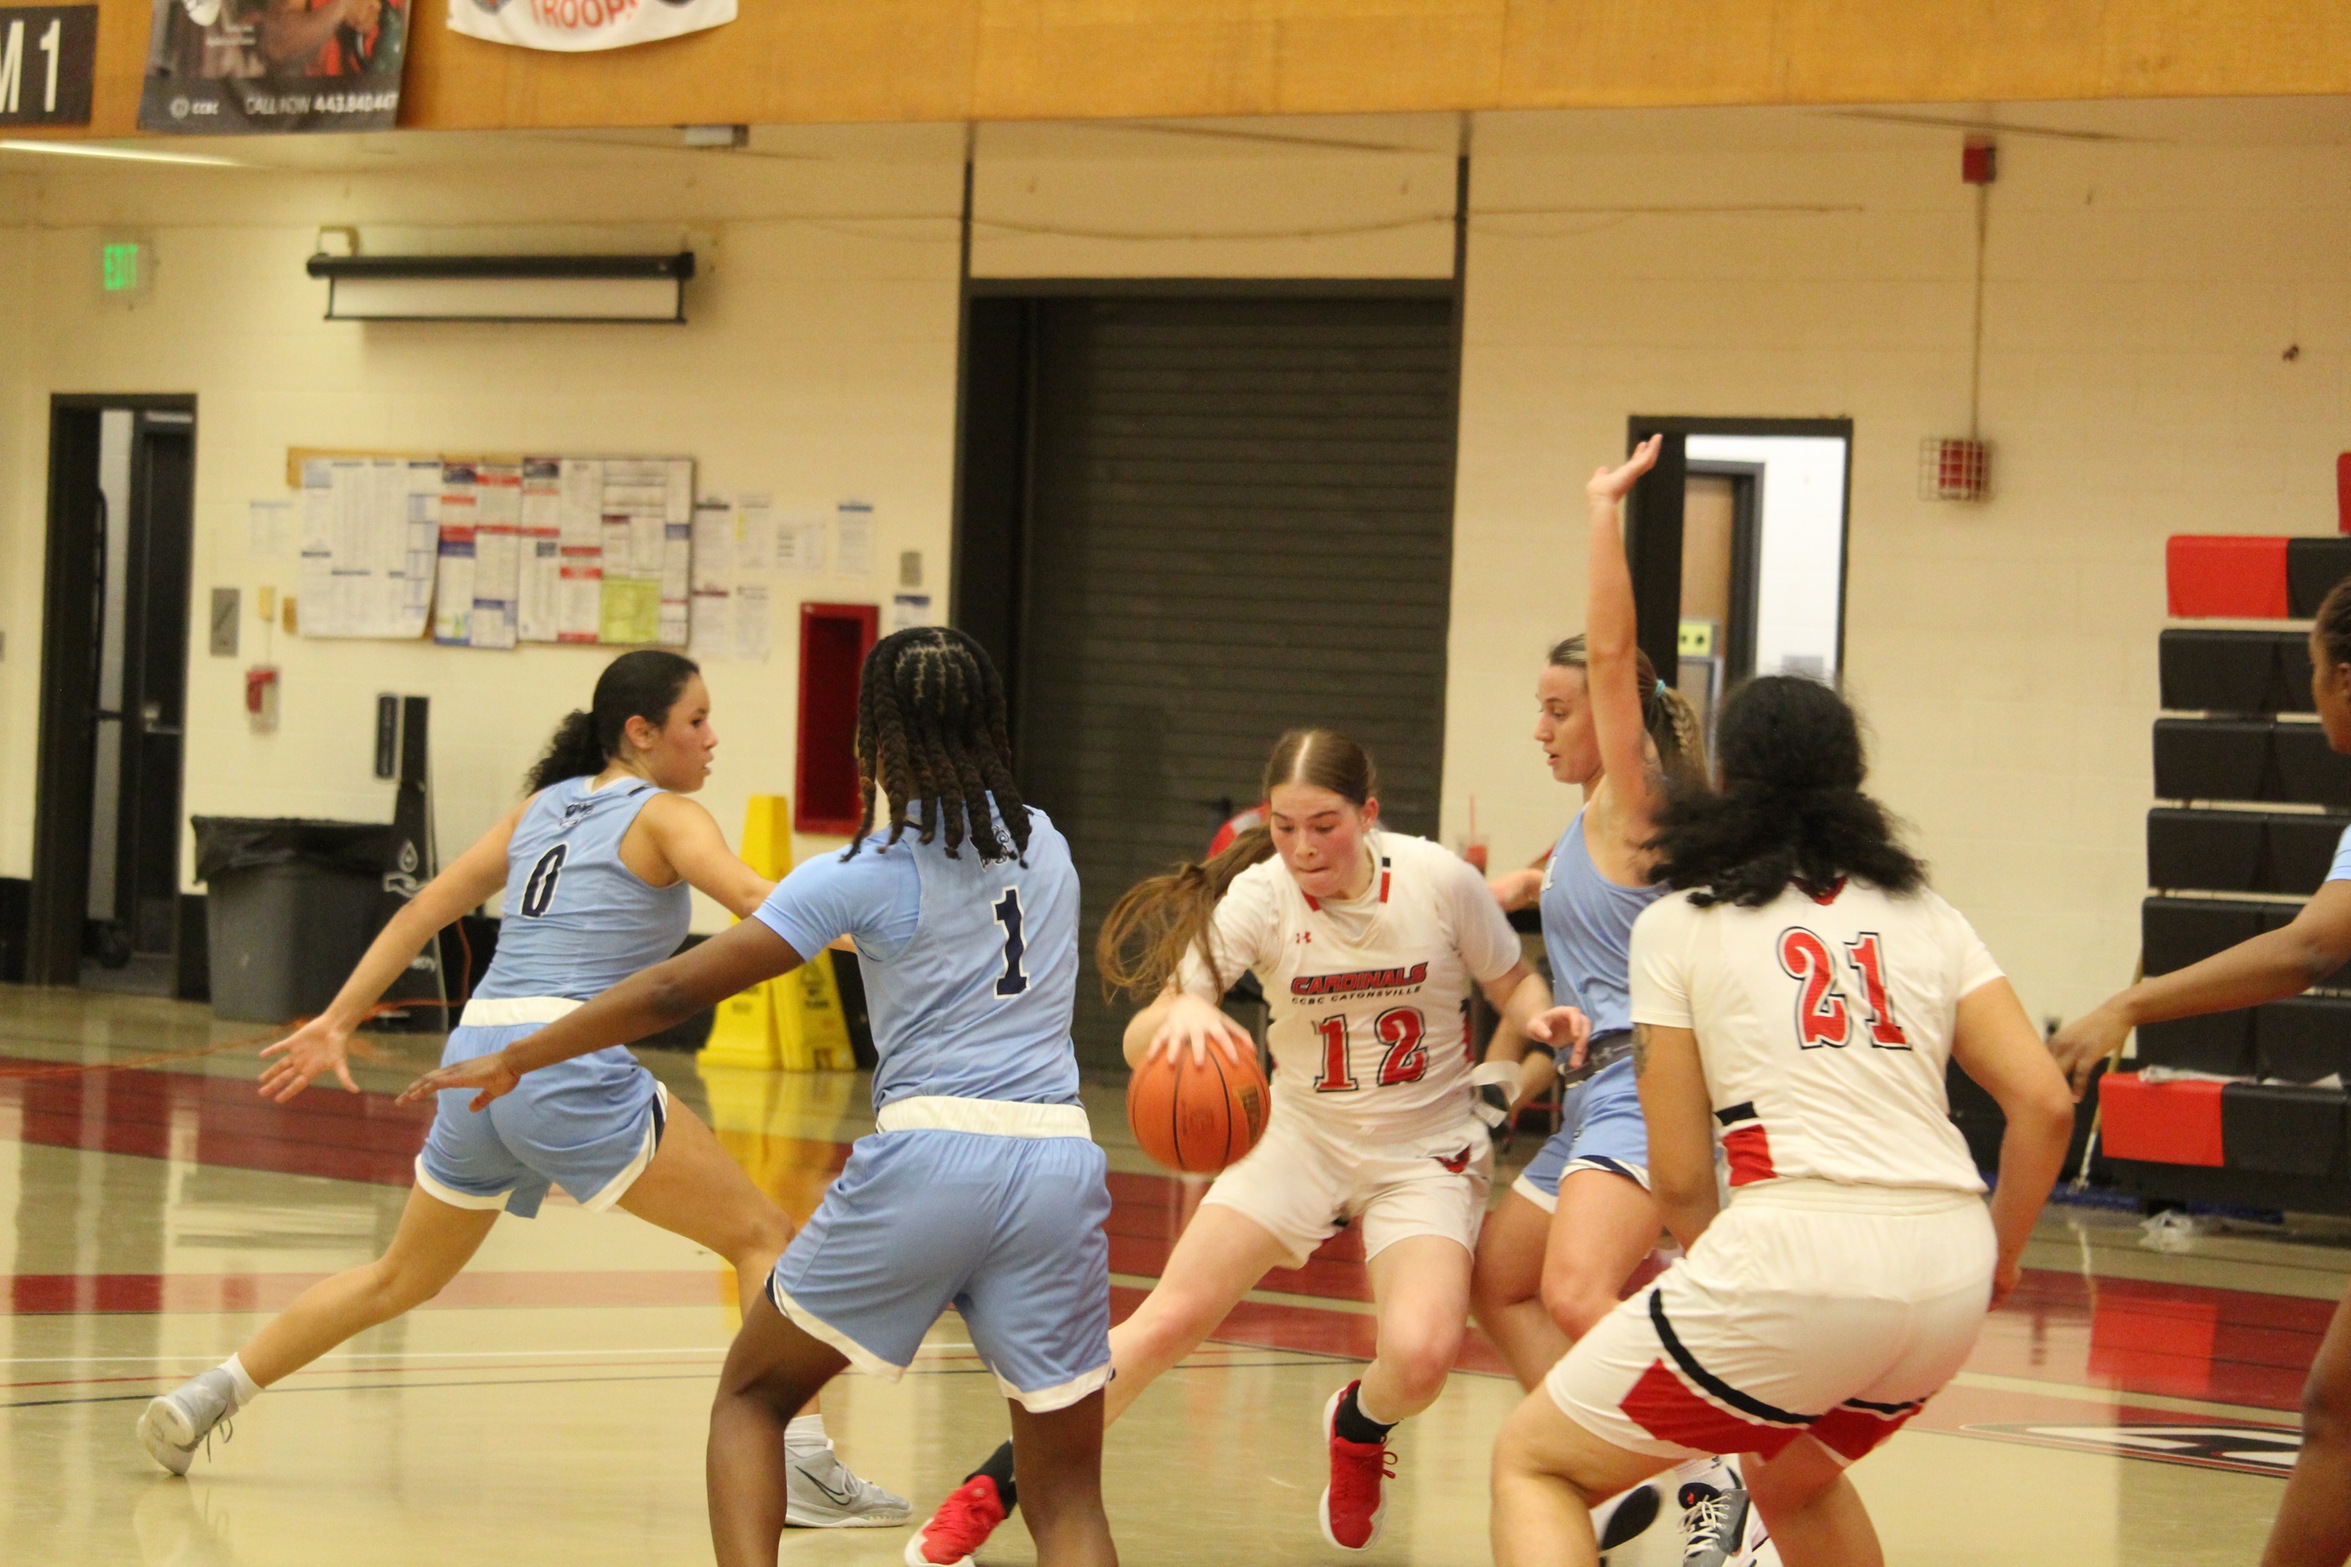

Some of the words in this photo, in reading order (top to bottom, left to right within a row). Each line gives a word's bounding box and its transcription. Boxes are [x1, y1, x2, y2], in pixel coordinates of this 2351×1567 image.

[40, 18, 61, 112] 1
[246, 97, 276, 115] CALL
[519, 841, 569, 919] 0
[991, 884, 1031, 999] 1
[1290, 961, 1429, 996] CARDINALS
[1291, 996, 1325, 1006] CCBC
[1331, 985, 1422, 1003] CATONSVILLE
[1776, 926, 1912, 1051] 21
[1312, 1006, 1429, 1093] 12
